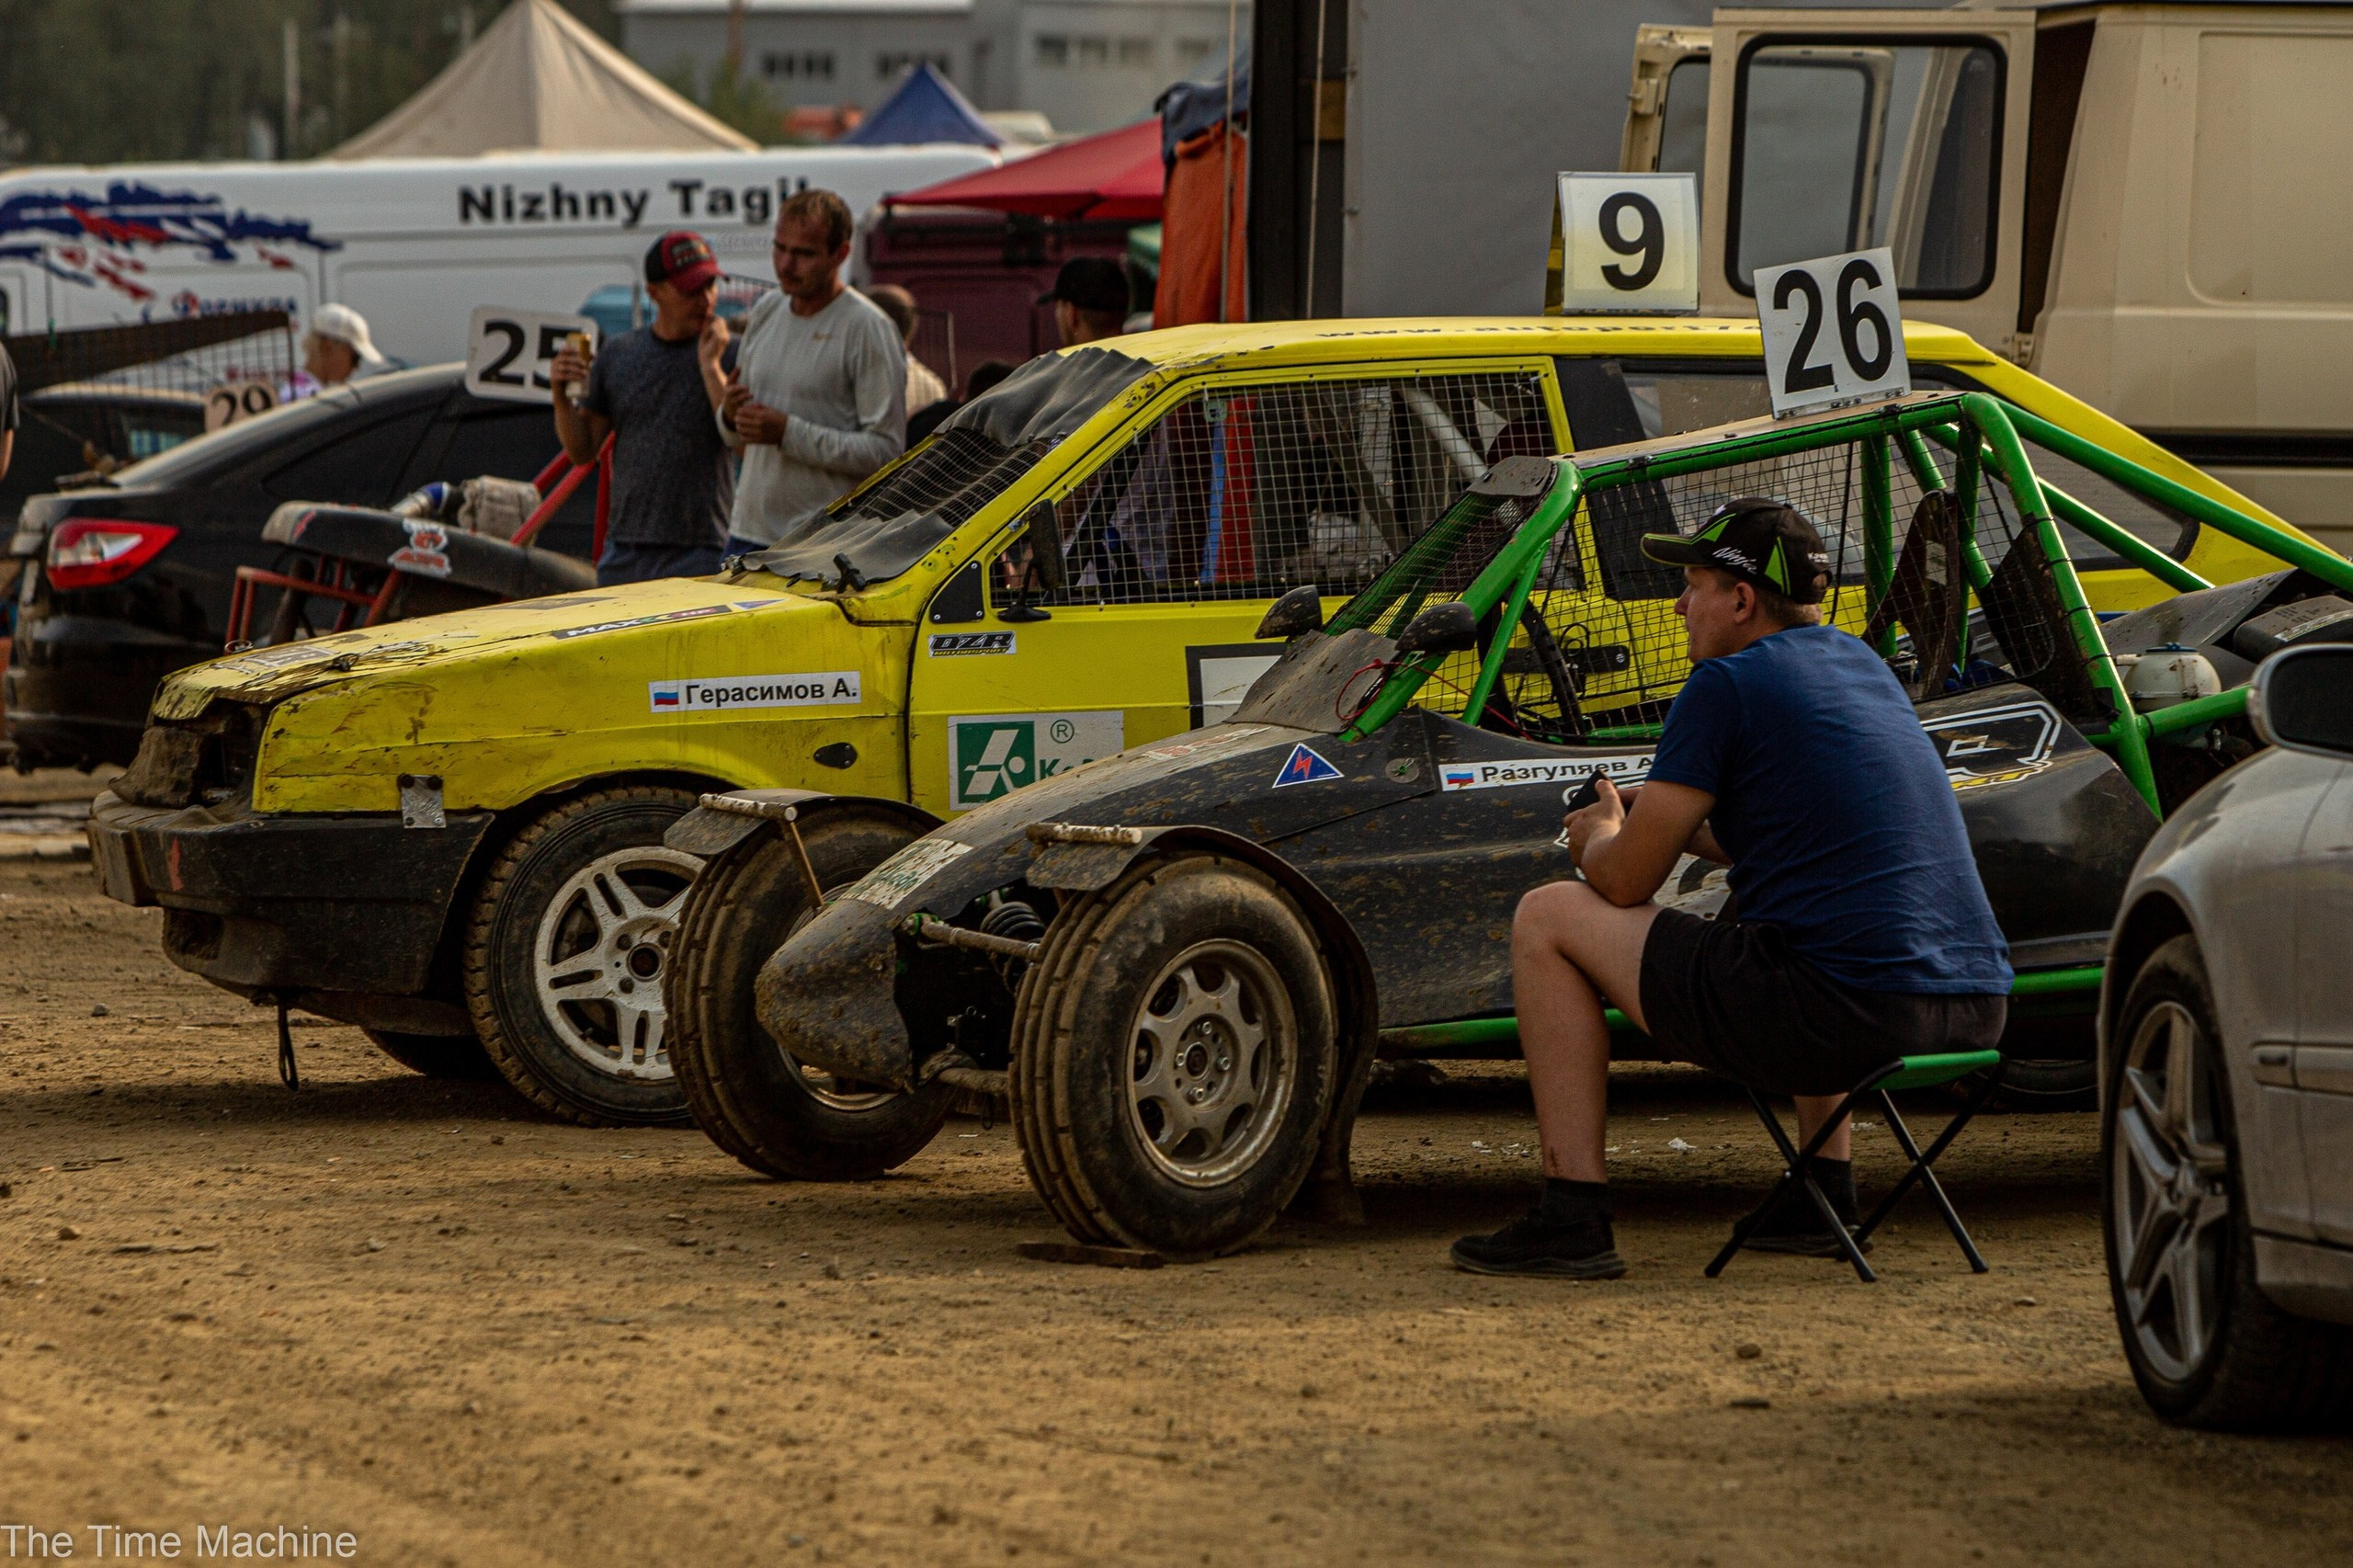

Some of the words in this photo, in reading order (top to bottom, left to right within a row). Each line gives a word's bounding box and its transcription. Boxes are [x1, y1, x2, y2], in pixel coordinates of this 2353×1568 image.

[459, 183, 649, 228] Nizhny
[1598, 190, 1665, 291] 9
[1772, 258, 1893, 394] 26
[686, 683, 825, 708] Герасимов
[832, 677, 858, 698] А.
[1481, 760, 1628, 782] Разгуляев
